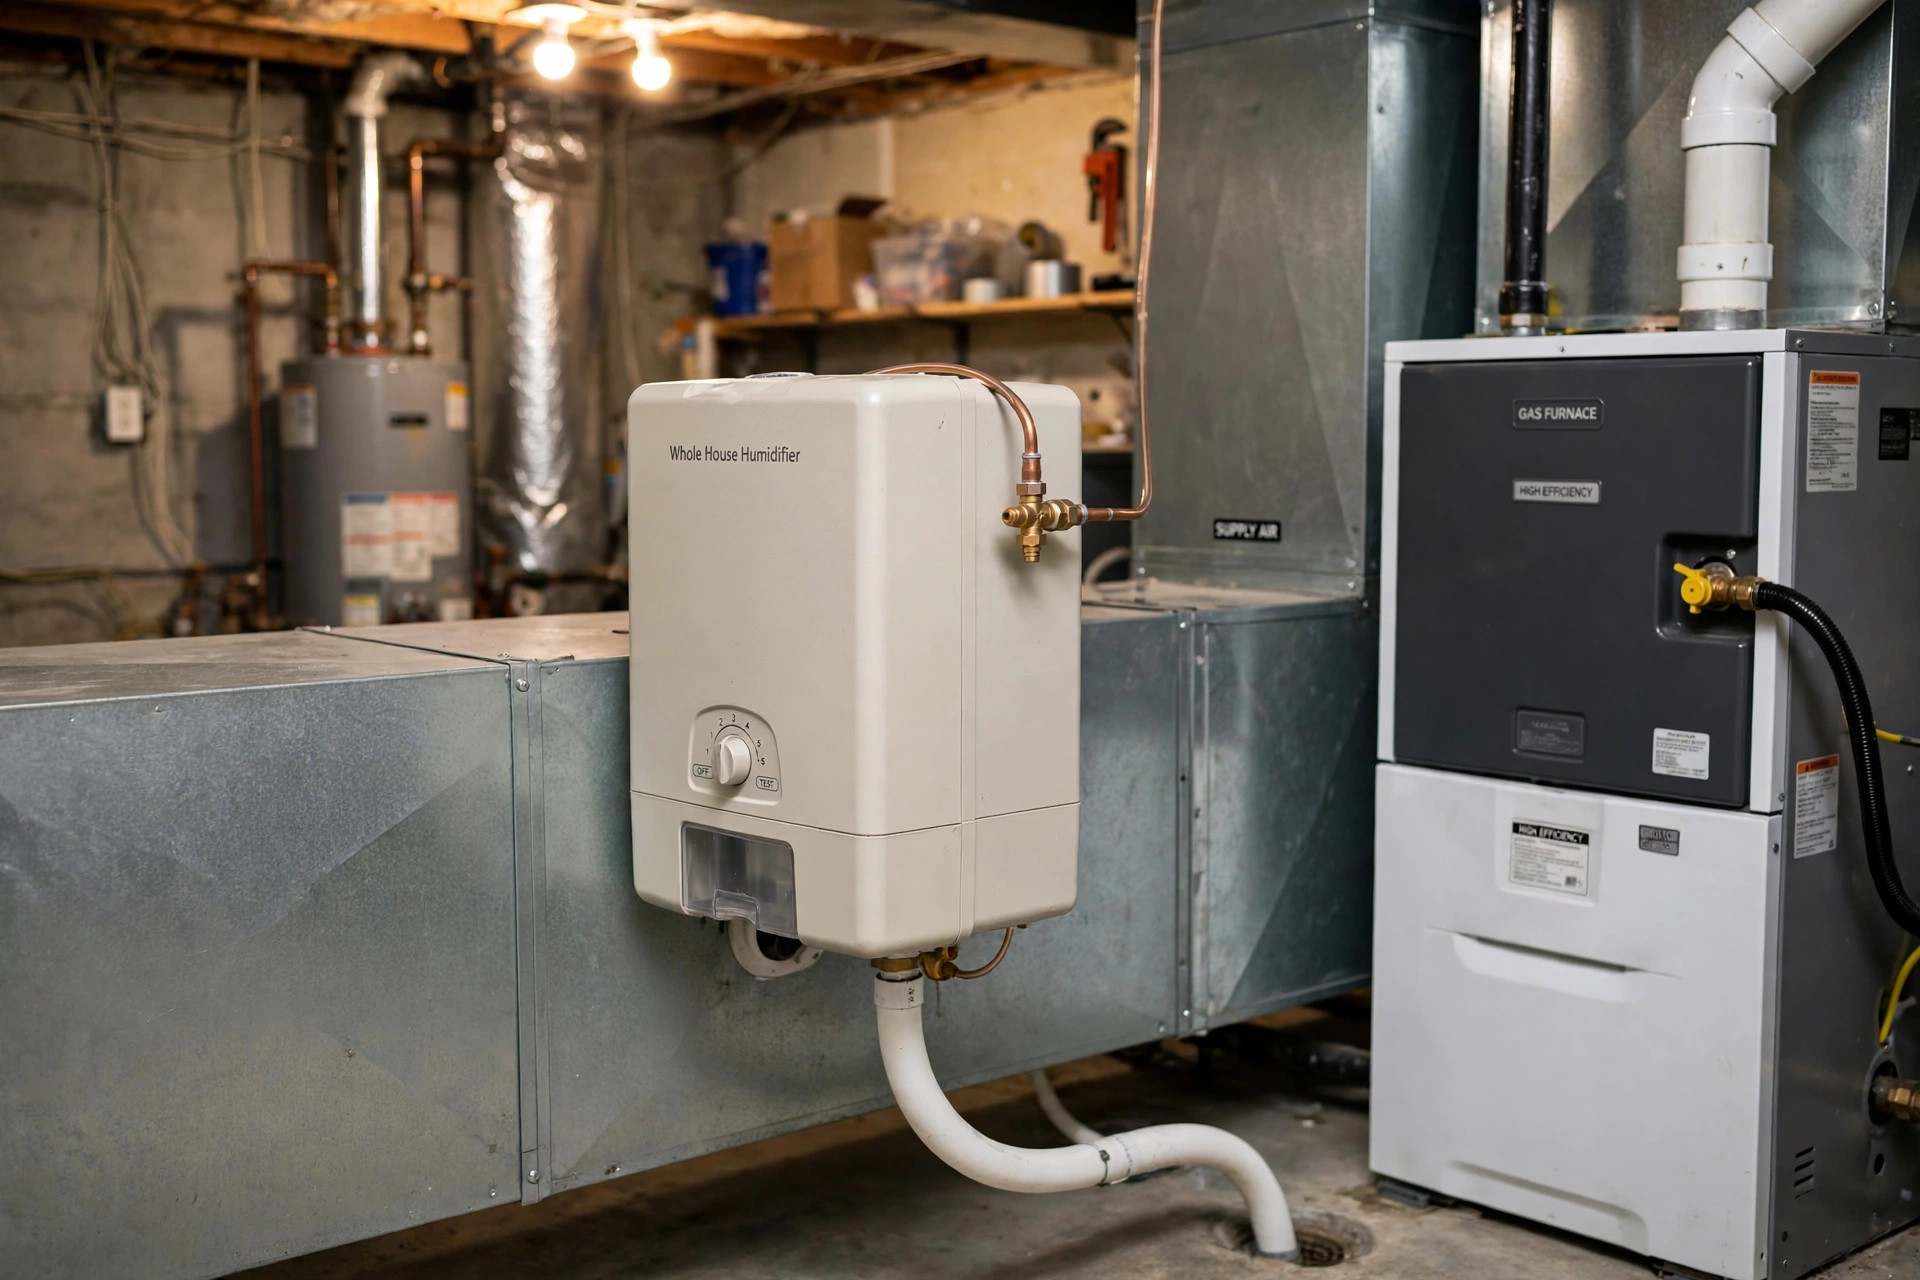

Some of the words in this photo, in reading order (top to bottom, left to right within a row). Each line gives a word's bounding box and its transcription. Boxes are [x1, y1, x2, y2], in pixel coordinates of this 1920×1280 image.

[1518, 407, 1542, 420] GAS
[1544, 406, 1597, 420] FURNACE
[669, 445, 702, 461] Whole
[705, 445, 738, 462] House
[741, 445, 801, 463] Humidifier
[1520, 486, 1541, 497] HIGH
[1542, 487, 1594, 498] EFFICIENCY
[1215, 521, 1257, 539] SUPPLY
[1258, 523, 1279, 539] AIR
[697, 767, 709, 776] OFF
[759, 779, 774, 789] TEST
